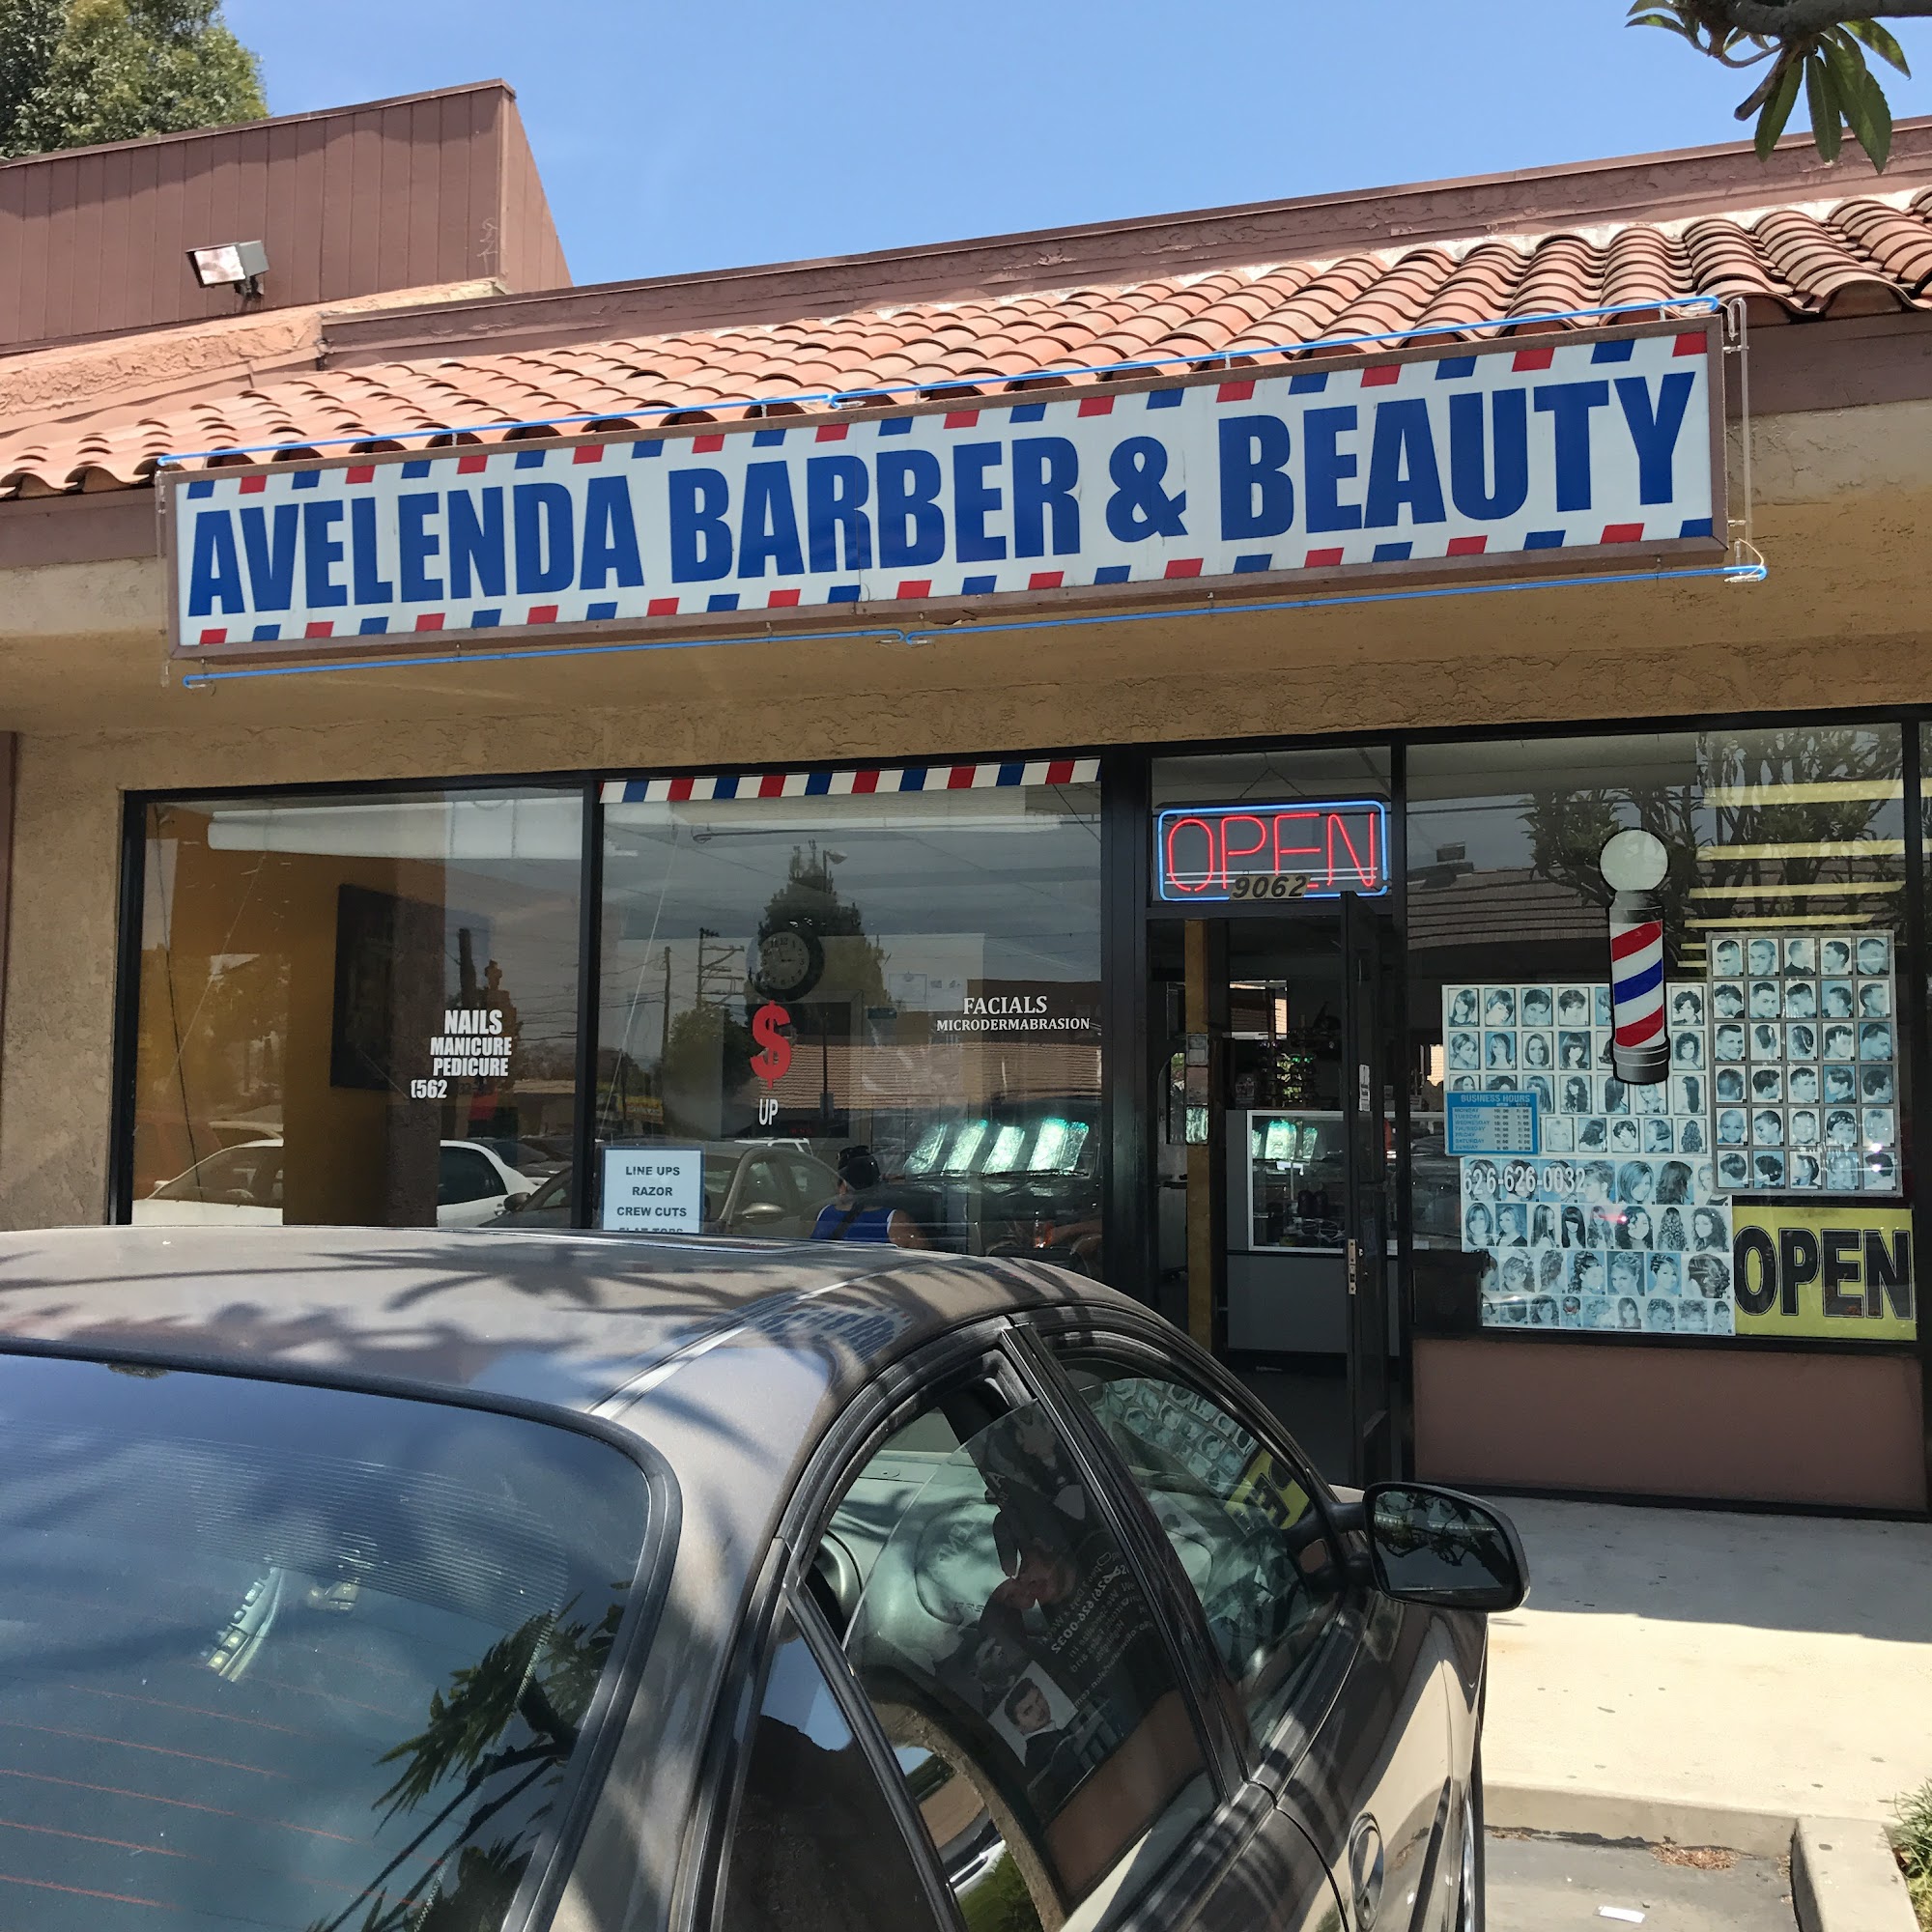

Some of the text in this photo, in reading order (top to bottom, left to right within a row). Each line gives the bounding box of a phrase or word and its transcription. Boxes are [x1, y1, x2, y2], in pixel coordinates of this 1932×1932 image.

[187, 371, 1696, 617] AVELENDA BARBER & BEAUTY
[1167, 812, 1377, 893] OPEN
[1232, 876, 1307, 898] 9062
[963, 995, 1048, 1015] FACIALS
[443, 1009, 503, 1035] NAILS
[936, 1017, 1091, 1032] MICRODERMABRASION
[430, 1037, 513, 1056] MANICURE
[433, 1057, 509, 1077] PEDICURE
[411, 1079, 447, 1099] (562
[1461, 1094, 1531, 1103] BUSINESS HOURS
[758, 1098, 779, 1125] UP
[625, 1166, 680, 1177] LINE UPS
[1463, 1166, 1585, 1195] 626-626-0032
[632, 1186, 673, 1197] RAZOR
[616, 1207, 688, 1217] CREW CUTS
[1734, 1225, 1914, 1321] OPEN
